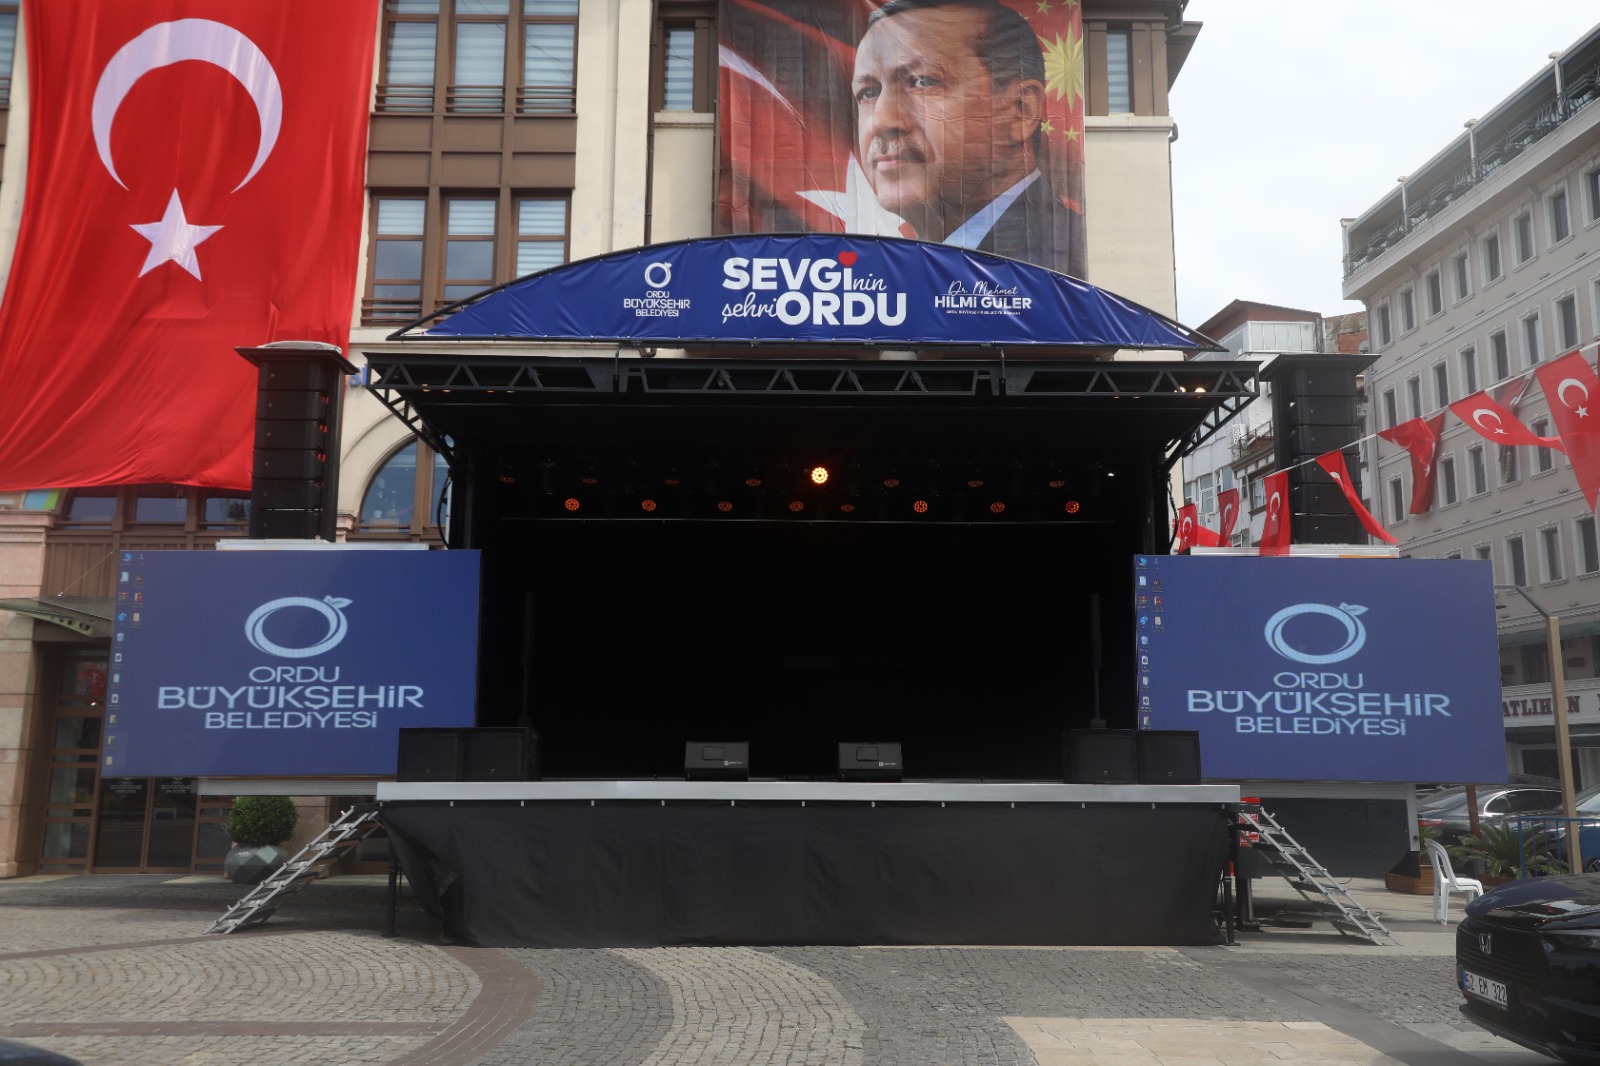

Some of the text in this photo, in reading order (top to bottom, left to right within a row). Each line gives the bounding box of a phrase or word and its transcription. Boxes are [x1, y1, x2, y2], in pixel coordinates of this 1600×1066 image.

[645, 290, 670, 299] ORDU
[973, 280, 1018, 297] Mehmet
[721, 291, 907, 326] şehri ORDU
[248, 666, 340, 684] ORDU
[1273, 671, 1363, 689] ORDU
[157, 685, 424, 709] BÜYÜKŞEHİR
[1187, 689, 1451, 717] BÜYÜKŞEHİR
[204, 711, 378, 729] BELEDİYESİ
[1235, 716, 1407, 736] BELEDİYESİ
